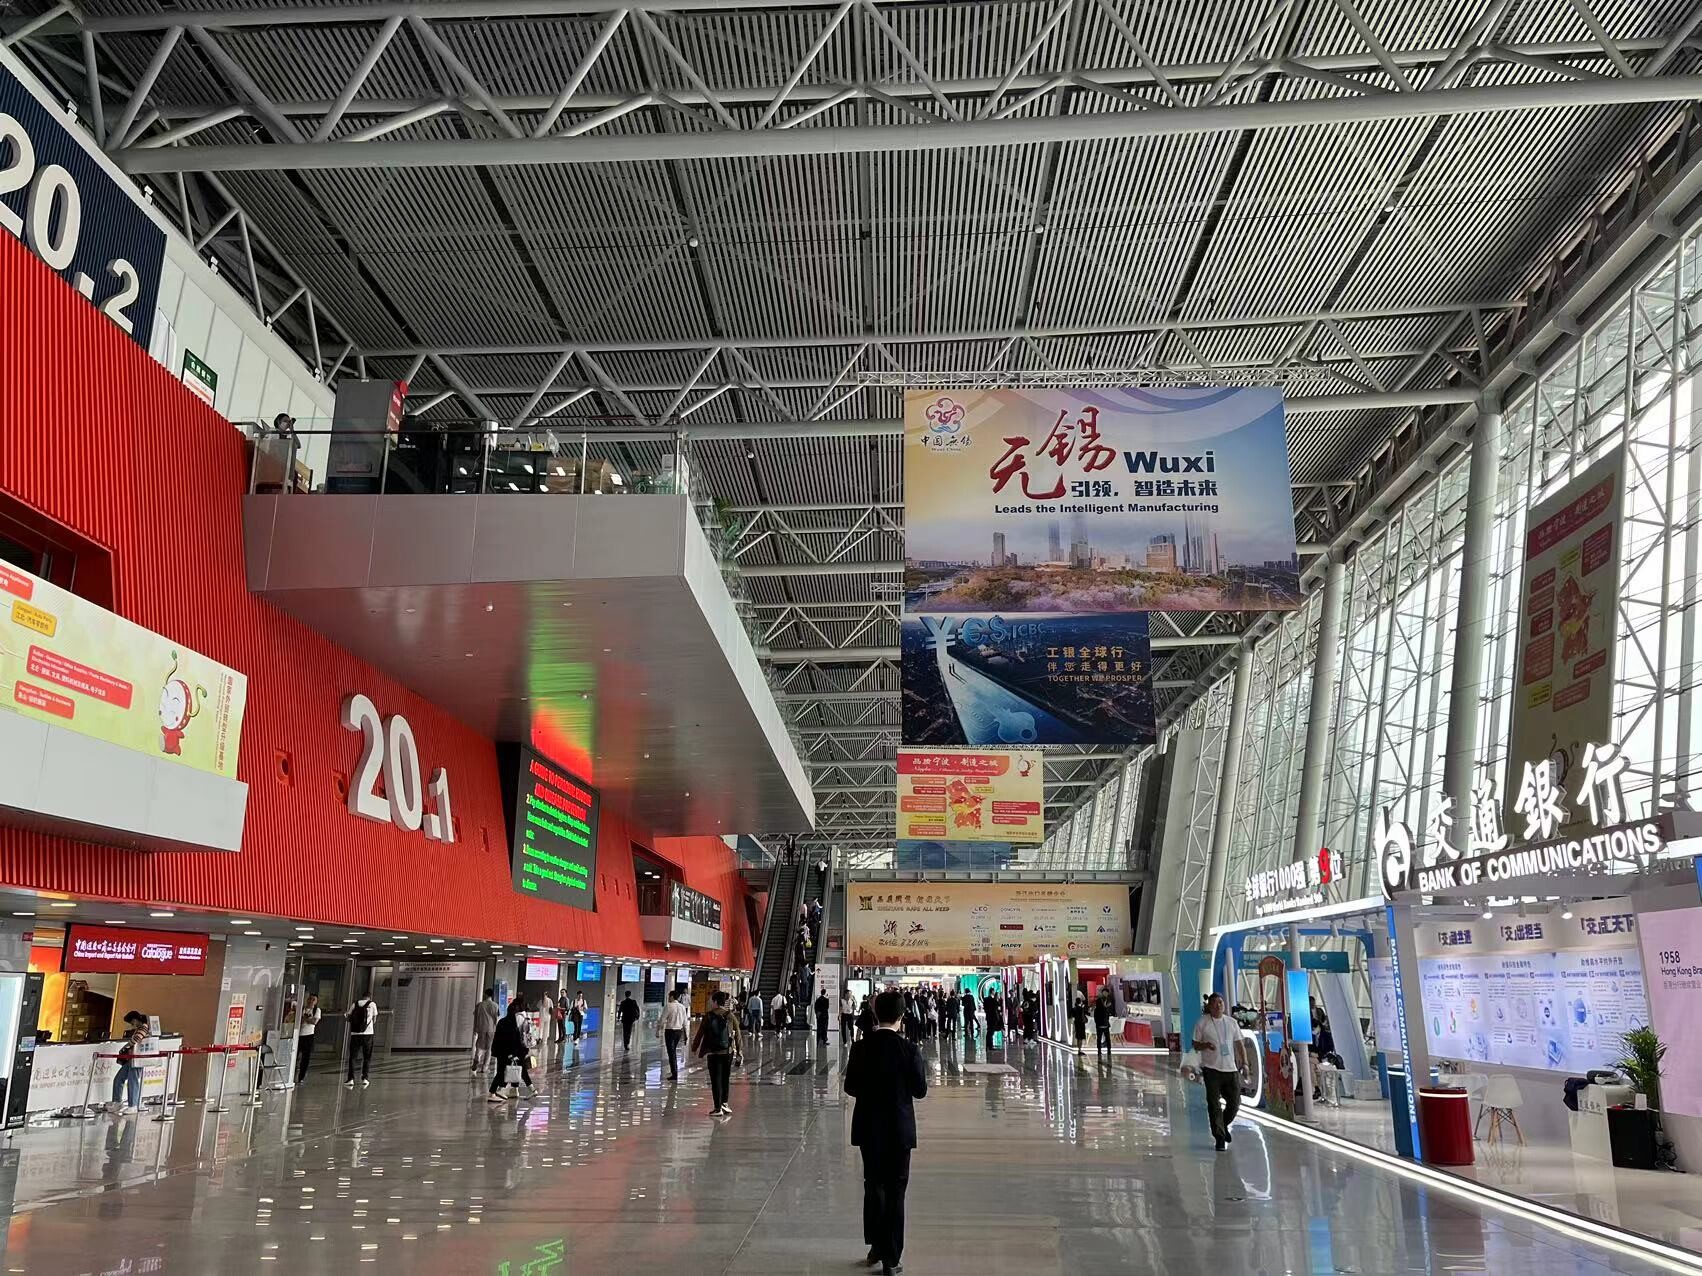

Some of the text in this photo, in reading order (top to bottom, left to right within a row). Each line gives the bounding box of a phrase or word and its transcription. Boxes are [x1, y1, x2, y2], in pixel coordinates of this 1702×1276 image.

[0, 112, 140, 335] 20.2
[1124, 451, 1215, 474] Wuxi
[1134, 480, 1218, 497] 智造未来
[995, 502, 1219, 515] Leads the Intelligent Manufacturing
[1047, 646, 1124, 659] 工银全球行
[1047, 661, 1142, 672] 伴您走得更好
[342, 694, 455, 843] 20.1
[1419, 865, 1456, 892] BANK
[1461, 861, 1482, 886] OF
[1488, 823, 1663, 881] COMMUNICATIONS
[1659, 951, 1681, 964] 1958
[1661, 967, 1676, 977] Hong
[1677, 966, 1692, 977] Kong
[1390, 938, 1416, 1124] BANK OF COMMUNICATIONS
